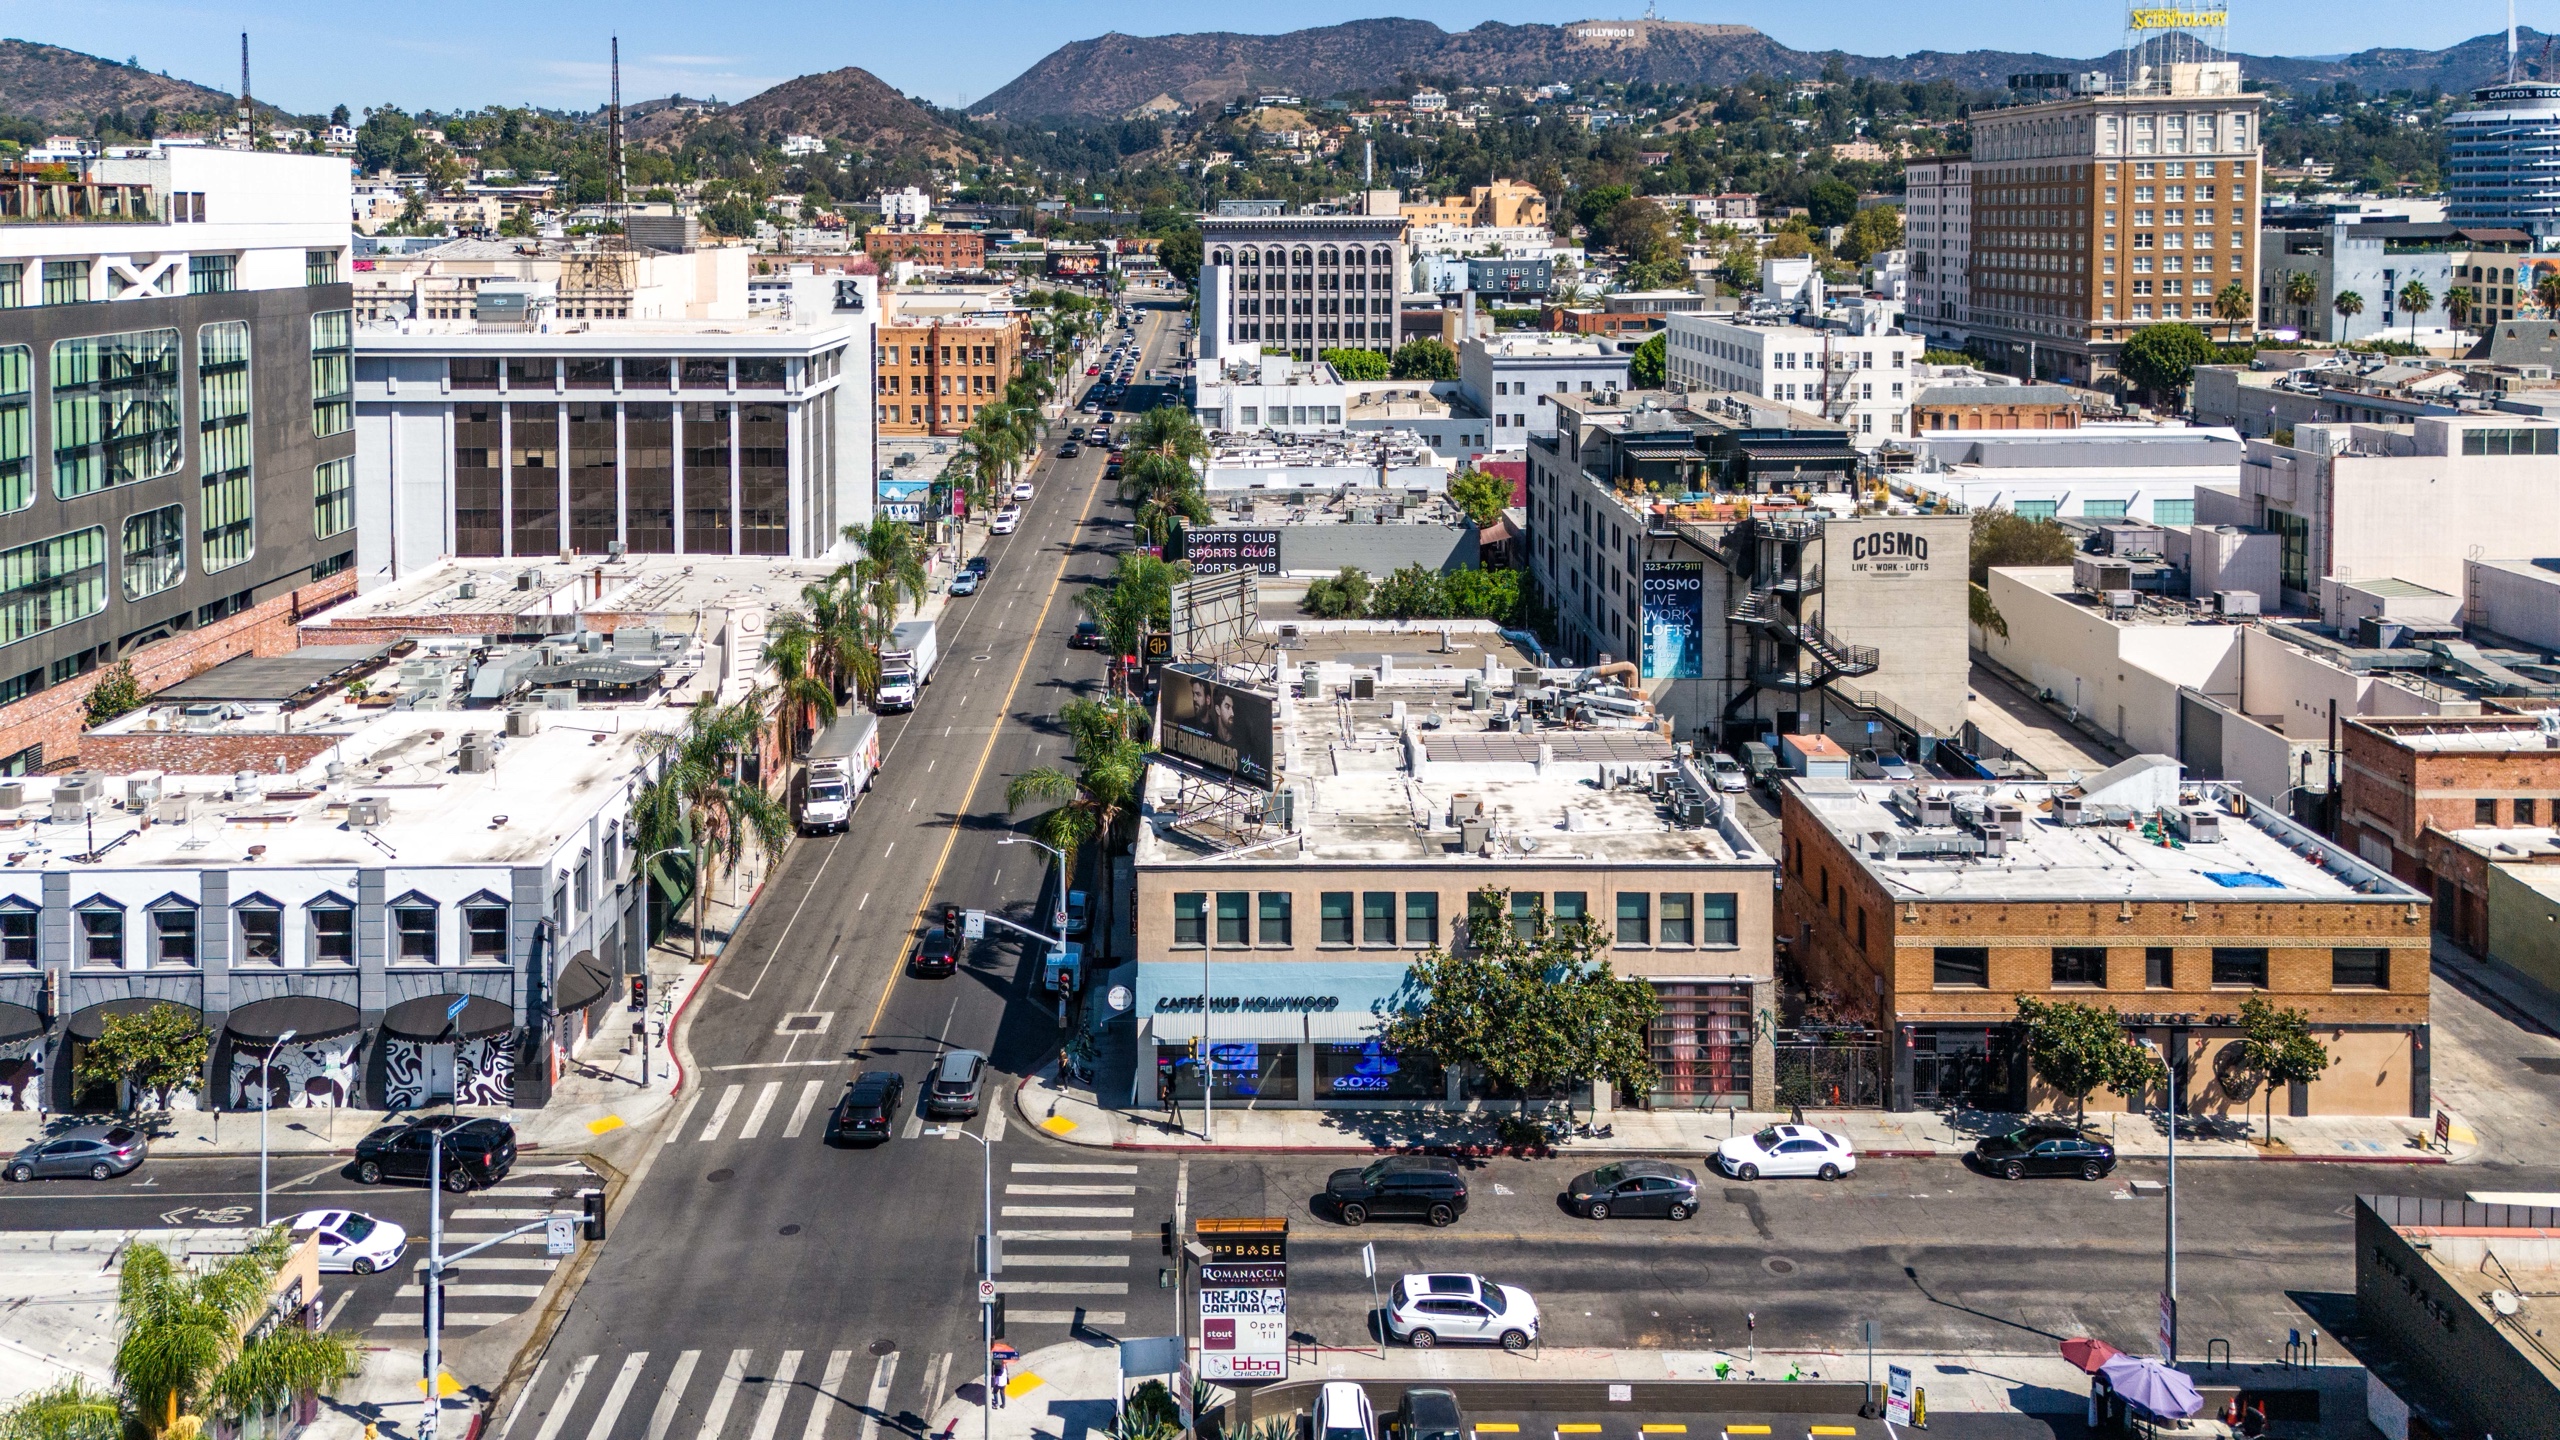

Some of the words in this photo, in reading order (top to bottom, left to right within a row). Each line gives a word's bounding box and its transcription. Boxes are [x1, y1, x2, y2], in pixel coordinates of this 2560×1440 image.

[2132, 9, 2227, 31] SCIENTOLOGY
[1578, 28, 1635, 38] HOLLYWOOD
[2488, 90, 2532, 99] CAPITOL
[1188, 533, 1237, 544] SPORTS
[1243, 533, 1276, 543] CLUB
[1853, 531, 1928, 561] COSMO
[1188, 548, 1237, 559] SPORTS
[1243, 547, 1276, 558] CLUB
[1189, 563, 1237, 573] SPORTS
[1644, 562, 1701, 571] 323-477-9111
[1852, 563, 1868, 572] LIVE
[1876, 563, 1898, 571] WORK
[1906, 563, 1929, 571] LOFTS
[1643, 578, 1700, 591] COSMO
[1644, 593, 1677, 606] LIVE
[1643, 609, 1692, 621] WORK
[1644, 624, 1692, 636] LOFTS
[1162, 726, 1178, 751] THE
[1177, 730, 1238, 772] CHAINSMOKERS
[1159, 994, 1205, 1009] CAFFÉ
[1209, 997, 1240, 1009] HUB
[1246, 996, 1340, 1009] HOLLYWOOD
[1333, 1077, 1389, 1087] 60%
[1201, 1290, 1260, 1304] TREJO'S
[1202, 1303, 1260, 1313] CANTINA
[1250, 1321, 1283, 1330] Open
[1207, 1330, 1233, 1338] stout
[1257, 1331, 1276, 1339] 'Til
